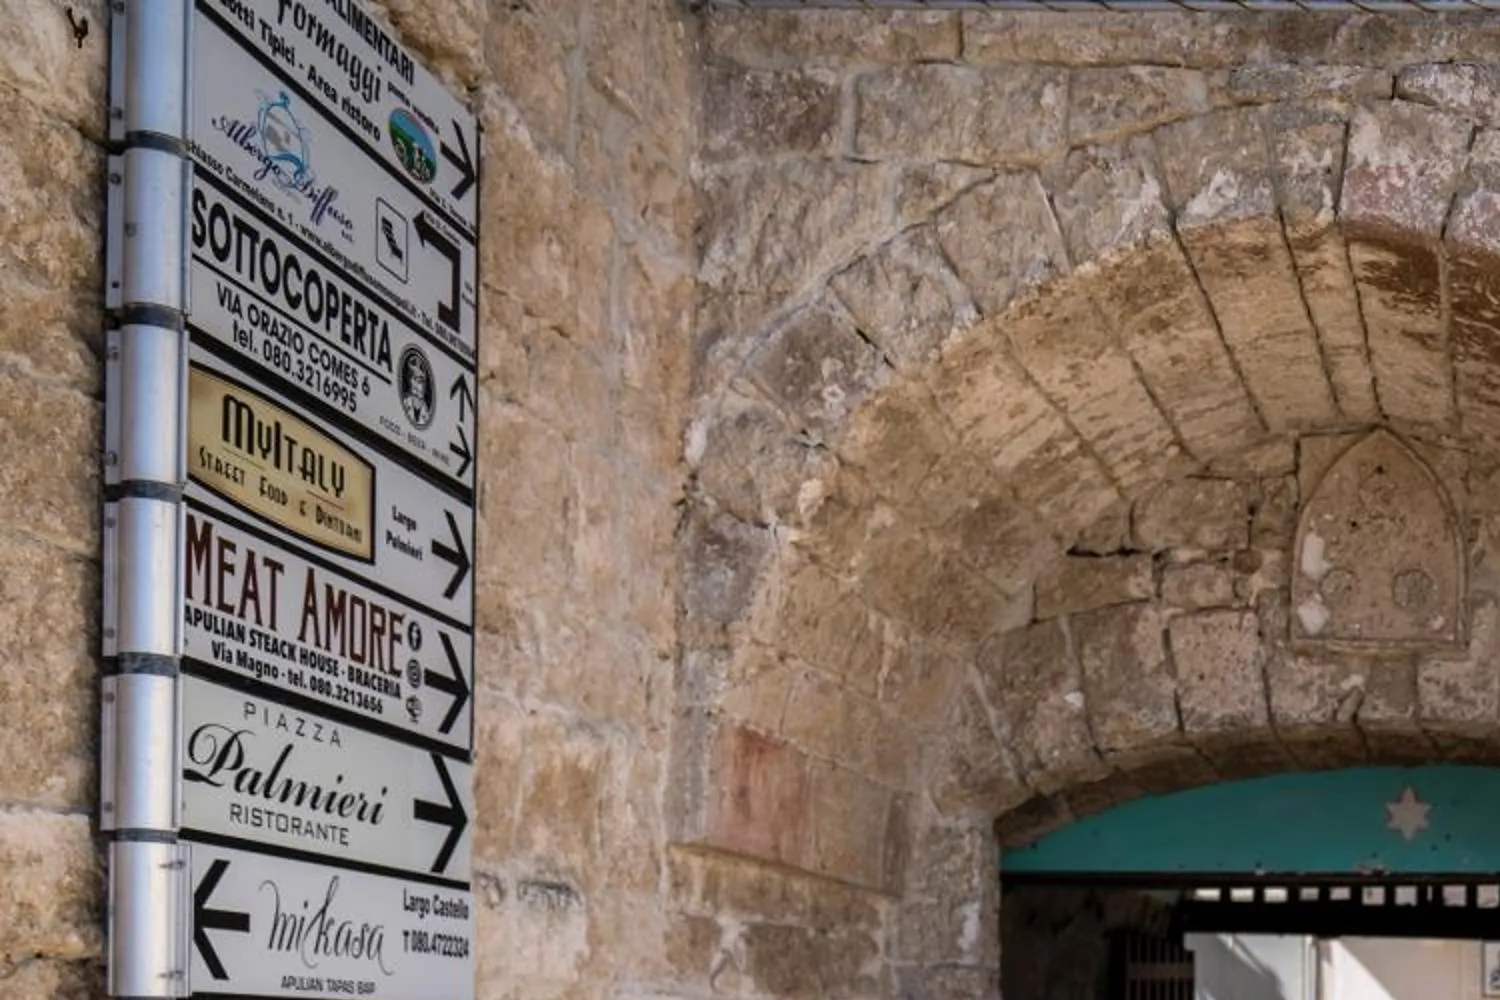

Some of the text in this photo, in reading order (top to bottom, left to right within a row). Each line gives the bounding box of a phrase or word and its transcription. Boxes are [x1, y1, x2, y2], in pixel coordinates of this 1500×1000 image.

[307, 64, 338, 104] Area
[342, 96, 381, 142] ristoro
[192, 187, 392, 373] SOTTOCOPERTA
[217, 282, 370, 396] VIA ORAZIO COMES 6
[233, 319, 357, 412] tel. 080.3216995
[199, 445, 246, 487] STREET
[259, 475, 289, 506] FOOD
[391, 504, 417, 532] Largo
[185, 513, 406, 679] MEAT AMORE
[184, 604, 245, 643] APULIAN
[249, 630, 298, 661] STEACK
[299, 646, 339, 677] HOUSE
[347, 664, 402, 699] BRACERIA
[211, 639, 233, 664] Via
[236, 649, 279, 680] Magno
[287, 667, 307, 688] tel.
[244, 701, 341, 748] PIAZZA
[183, 723, 388, 825] Palmieri
[229, 802, 350, 847] RISTORANTE
[403, 887, 430, 919] Largo
[281, 975, 323, 992] APULIAN
[326, 978, 354, 995] TAPAS
